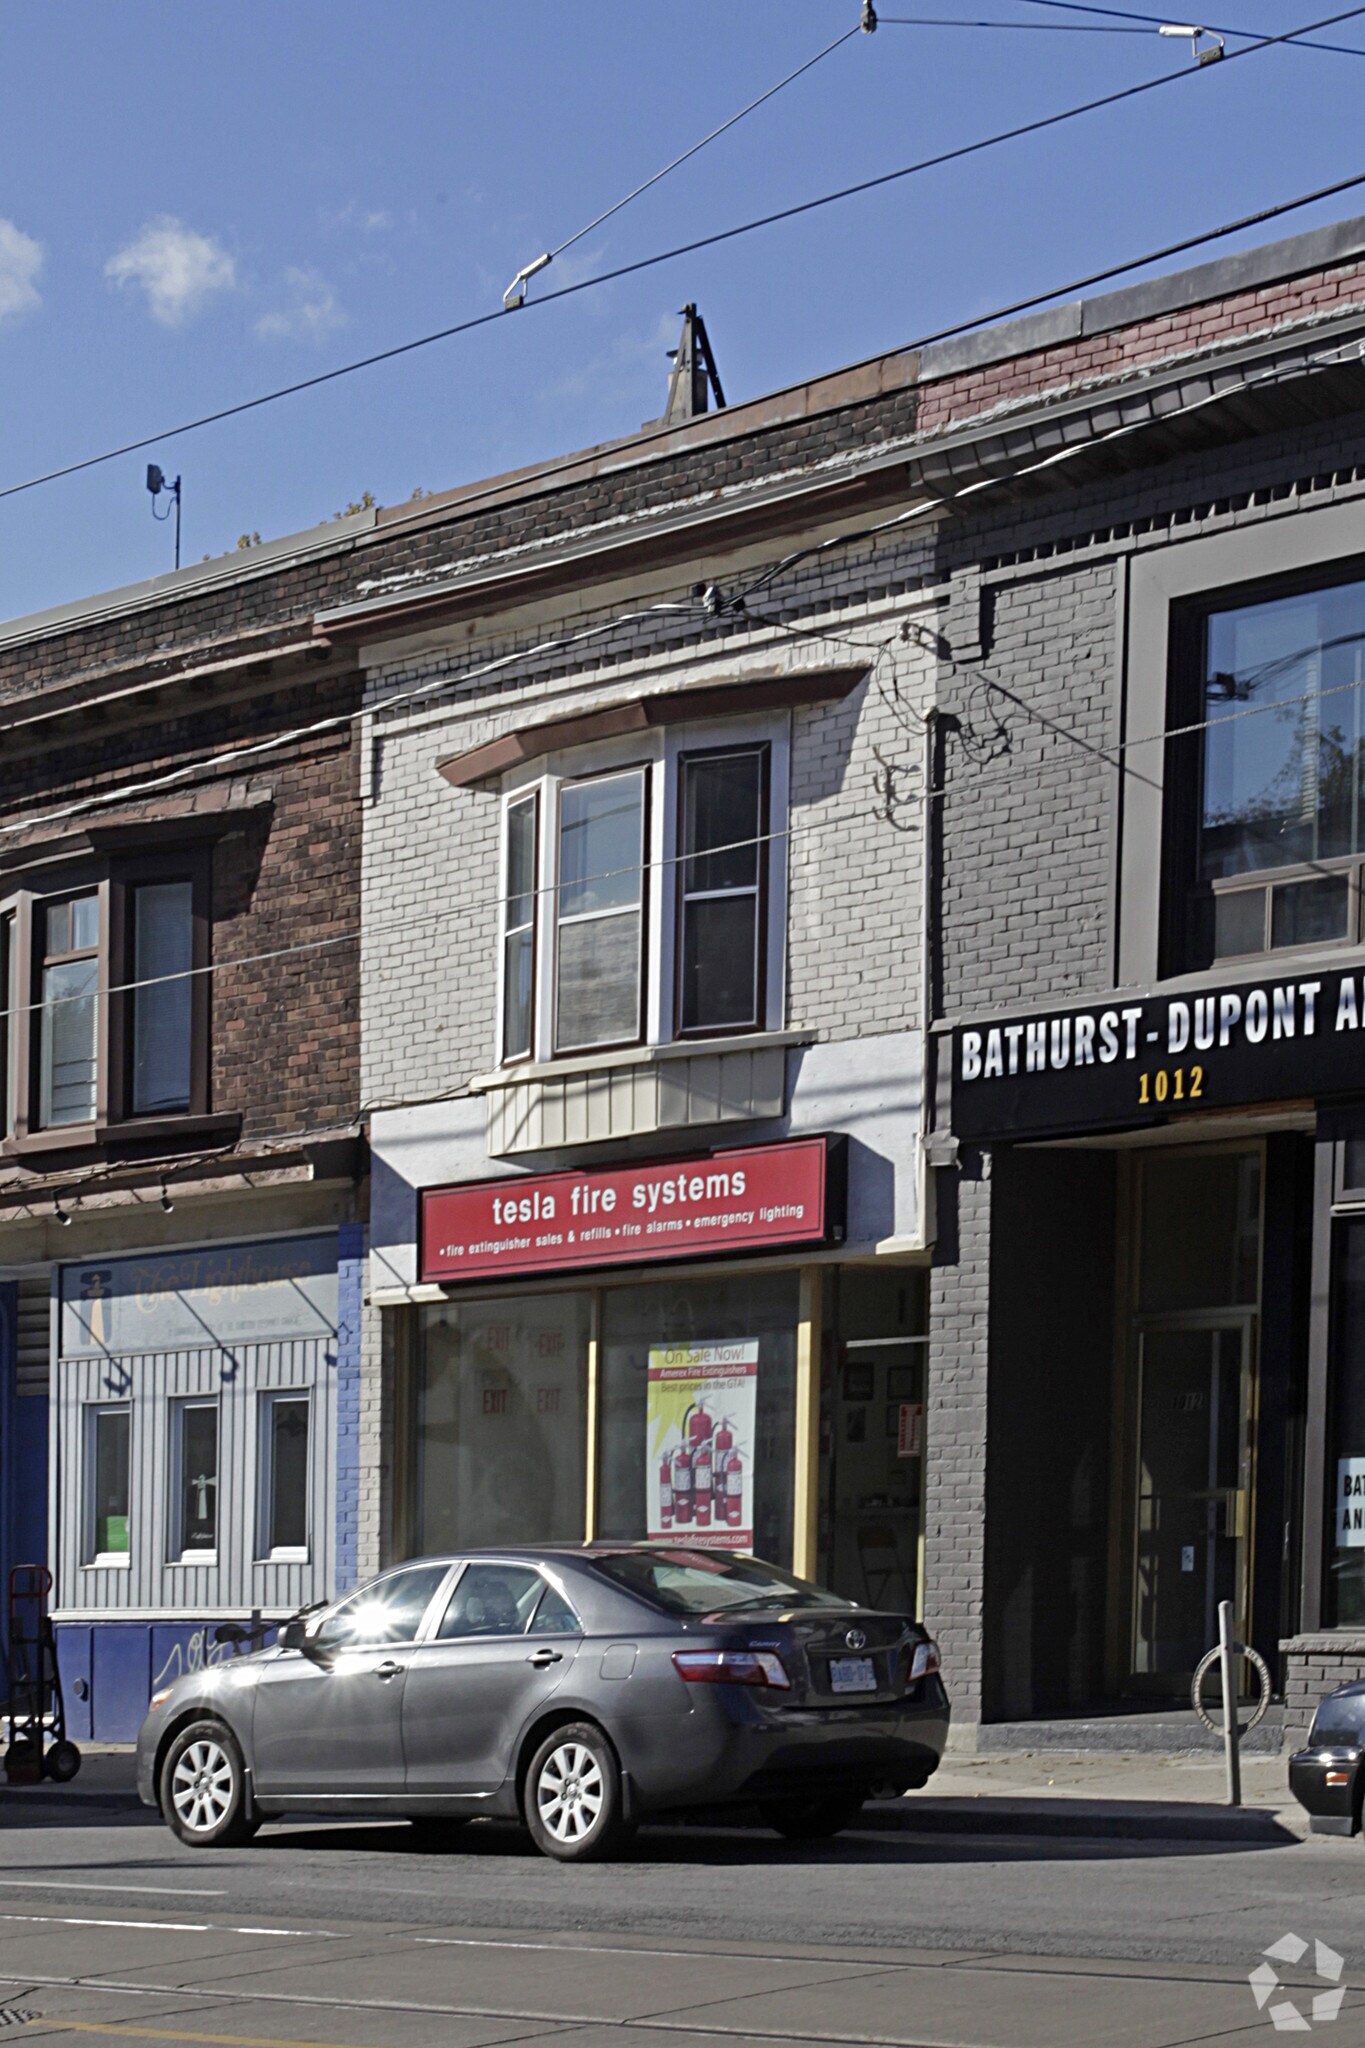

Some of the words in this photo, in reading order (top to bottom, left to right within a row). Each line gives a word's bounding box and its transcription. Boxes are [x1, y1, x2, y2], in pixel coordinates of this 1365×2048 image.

[1335, 973, 1365, 1031] A
[1139, 1065, 1203, 1104] 1012
[492, 1190, 556, 1226] tesla
[570, 1185, 617, 1216] fire
[632, 1170, 746, 1212] systems
[447, 1243, 464, 1257] fire
[468, 1237, 531, 1255] extinguisher
[535, 1232, 563, 1247] sales
[567, 1230, 575, 1242] &
[580, 1226, 611, 1241] refills
[622, 1222, 641, 1236] fire
[646, 1219, 683, 1233] alarms
[694, 1210, 755, 1228] emergency
[759, 1203, 804, 1221] lighting
[665, 1347, 682, 1364] On
[686, 1346, 711, 1362] Sale
[714, 1343, 745, 1361] Now!
[688, 1367, 701, 1377] Fire
[702, 1365, 747, 1377] Extinguishers
[483, 1389, 507, 1414] EXIT
[536, 1387, 561, 1413] EXIT
[1343, 1474, 1365, 1496] BA
[1342, 1508, 1365, 1530] AN
